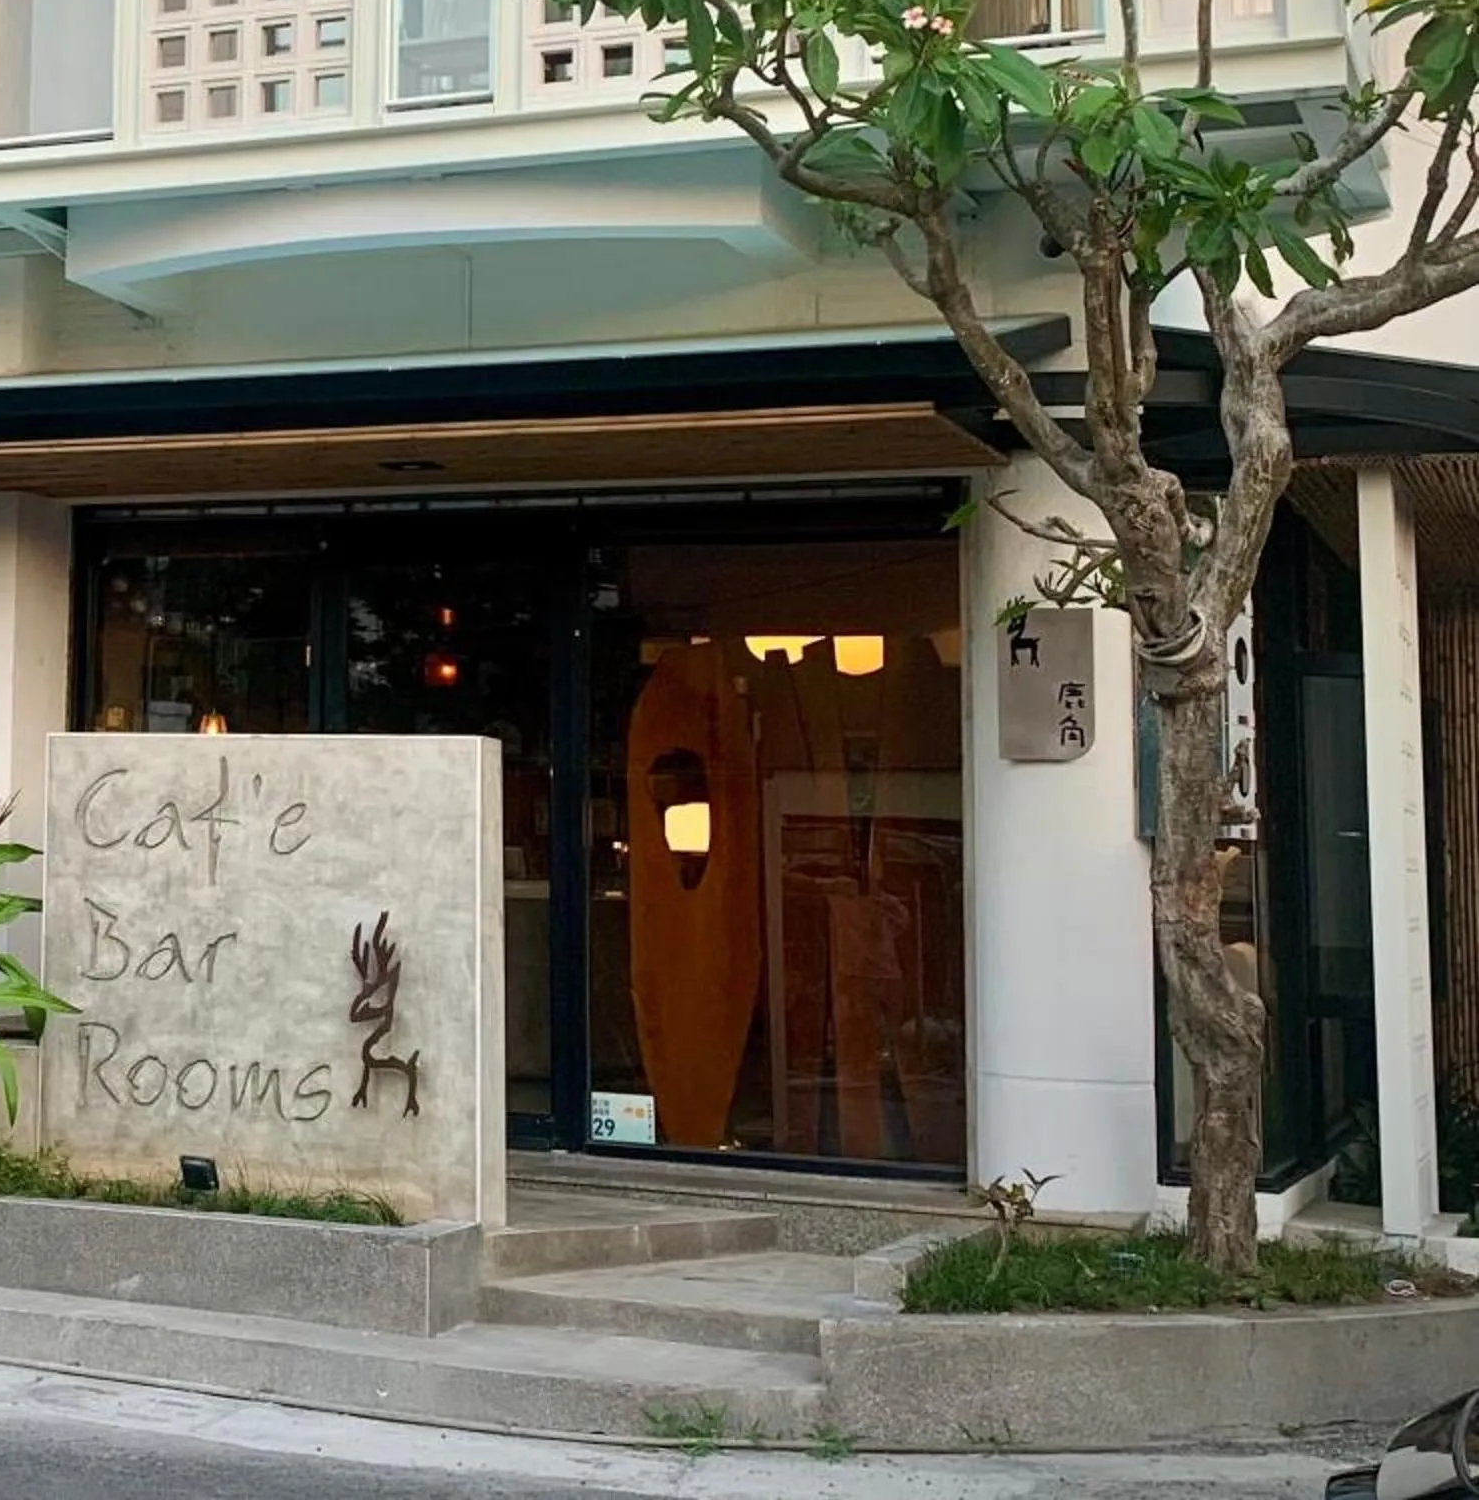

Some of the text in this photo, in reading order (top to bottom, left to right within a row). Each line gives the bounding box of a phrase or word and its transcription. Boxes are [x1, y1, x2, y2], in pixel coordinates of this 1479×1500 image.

[1058, 681, 1087, 748] 鹿角
[80, 897, 238, 983] Bar
[77, 1021, 333, 1121] Rooms
[593, 1117, 616, 1137] 29
